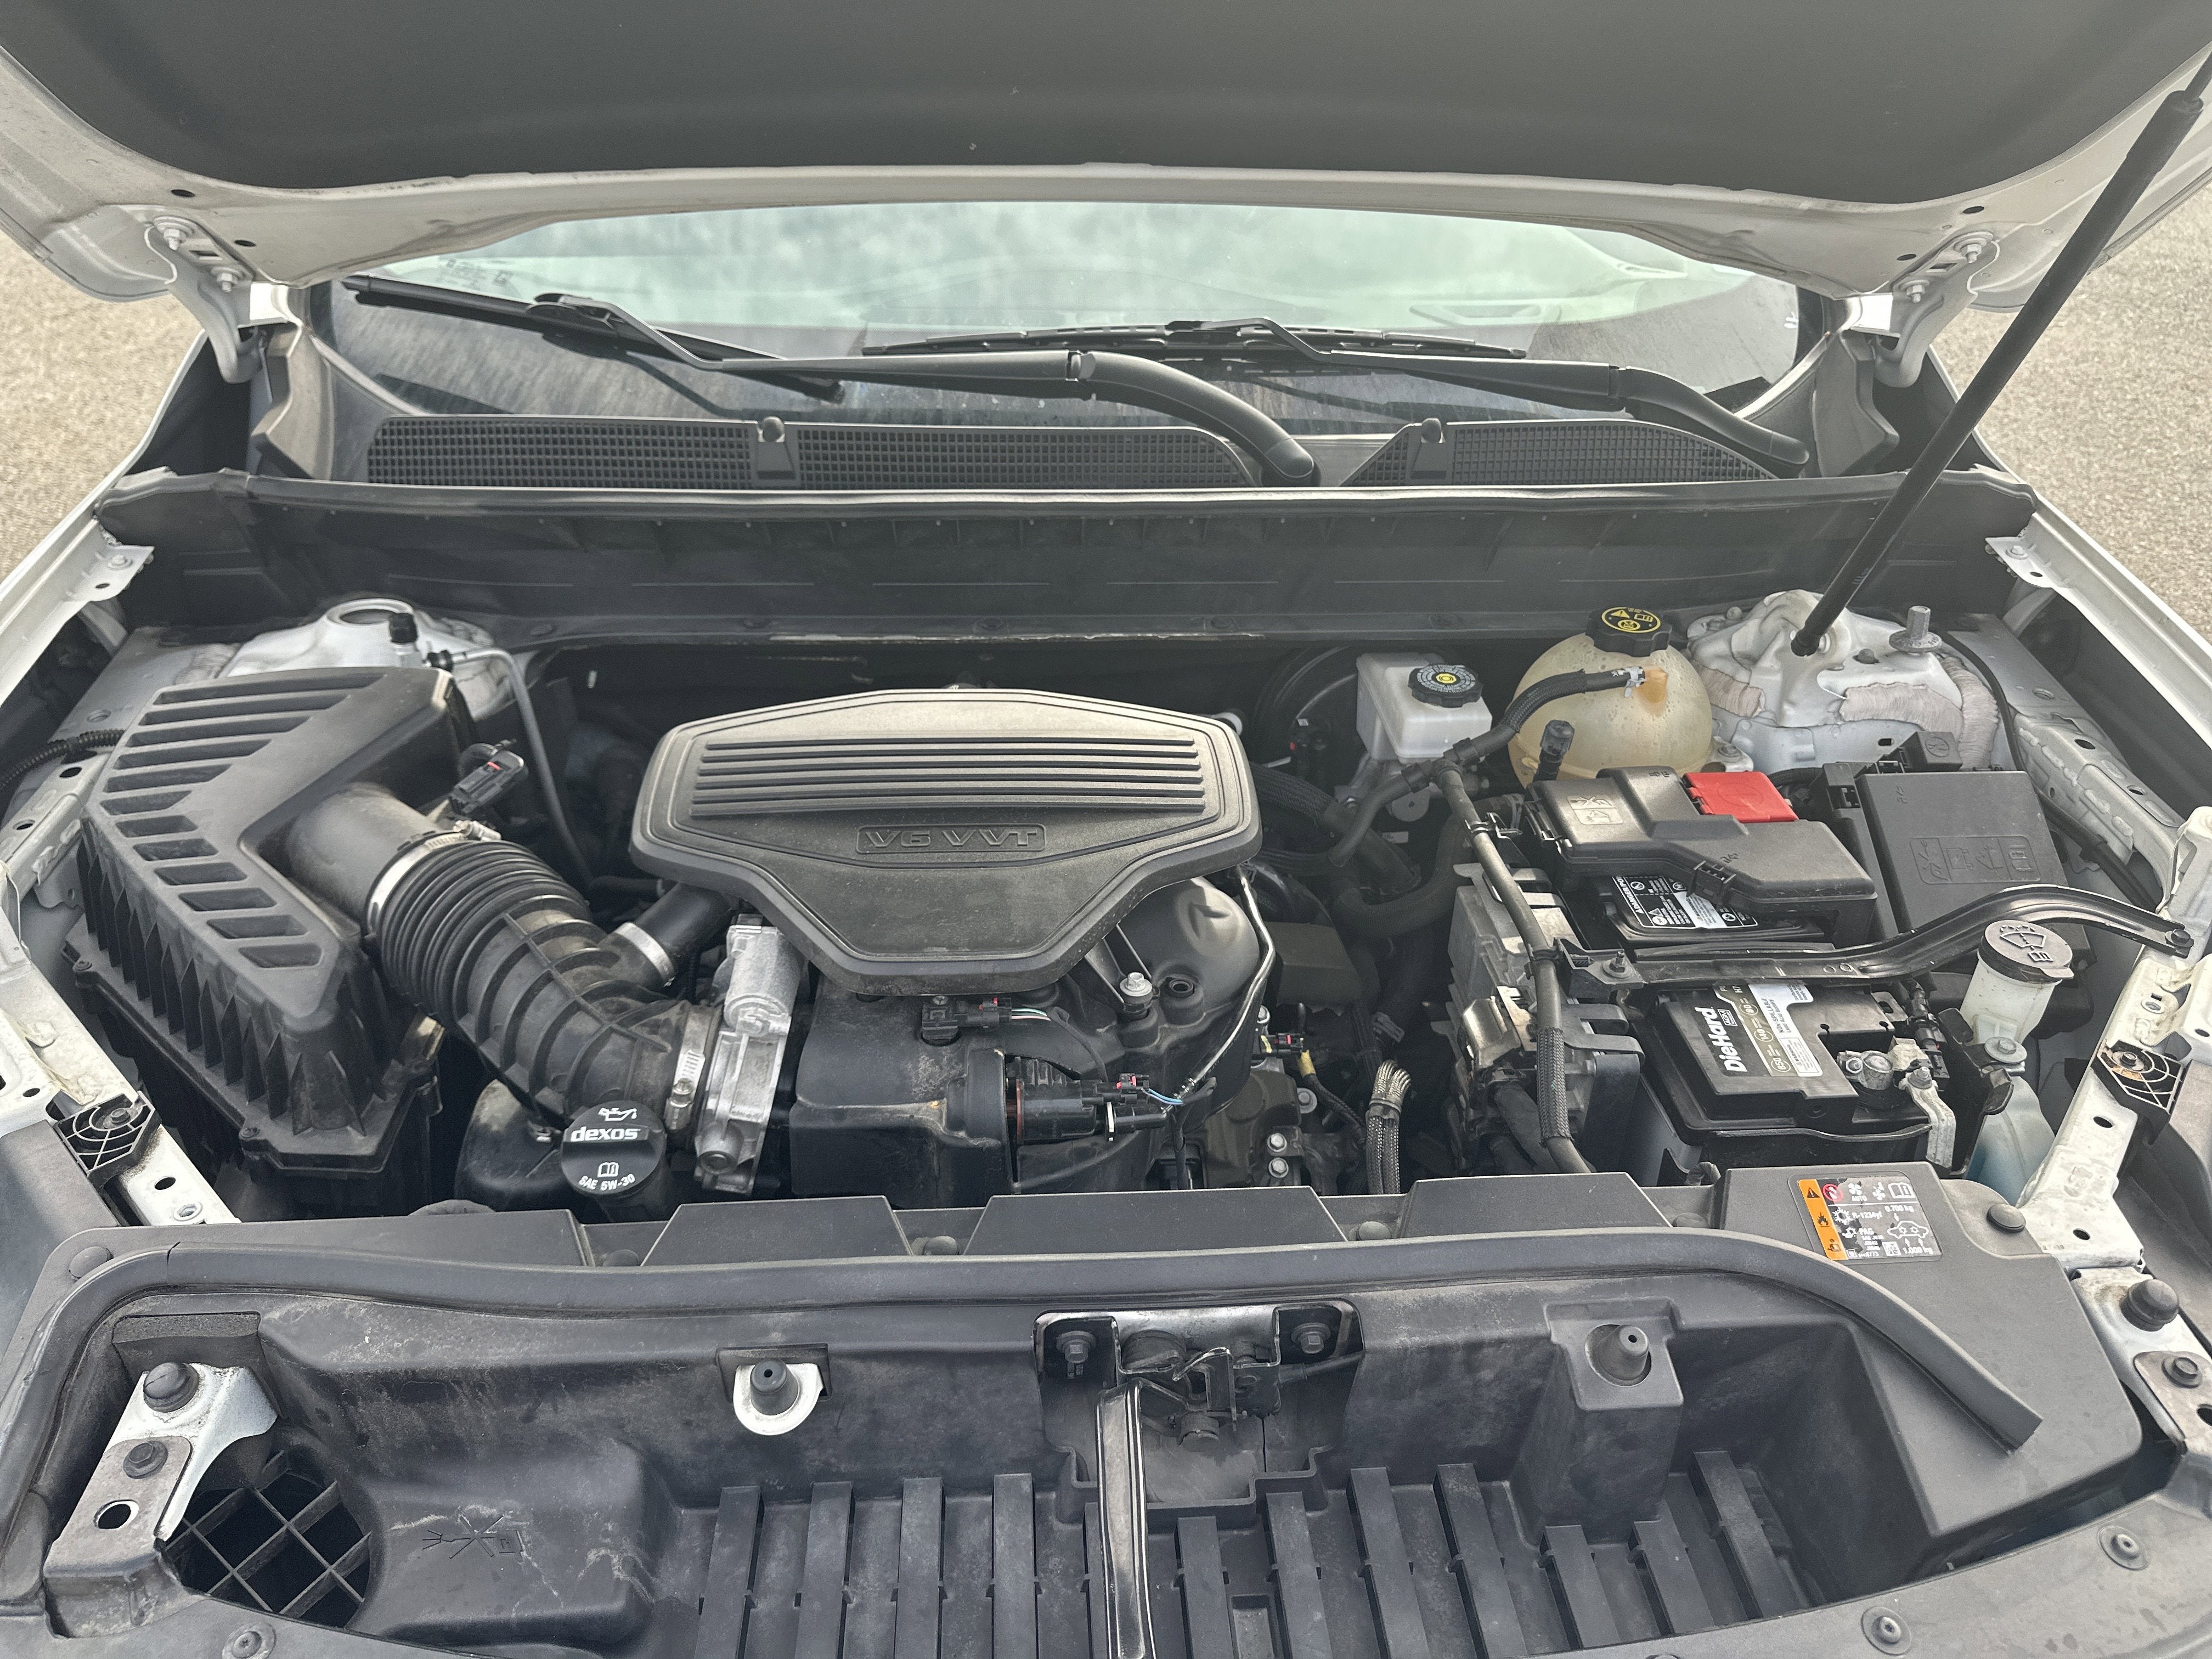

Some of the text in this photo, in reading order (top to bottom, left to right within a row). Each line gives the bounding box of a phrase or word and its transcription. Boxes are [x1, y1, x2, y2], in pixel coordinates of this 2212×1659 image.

[865, 829, 1037, 848] V6 VVT
[1719, 1011, 1731, 1024] AGM
[1695, 1007, 1747, 1072] DieHard
[1756, 1029, 1769, 1039] 140
[1774, 1058, 1786, 1069] 850
[571, 1126, 638, 1142] dexos
[579, 1174, 635, 1191] SAE 5W-30
[1922, 1246, 1933, 1255] kg
